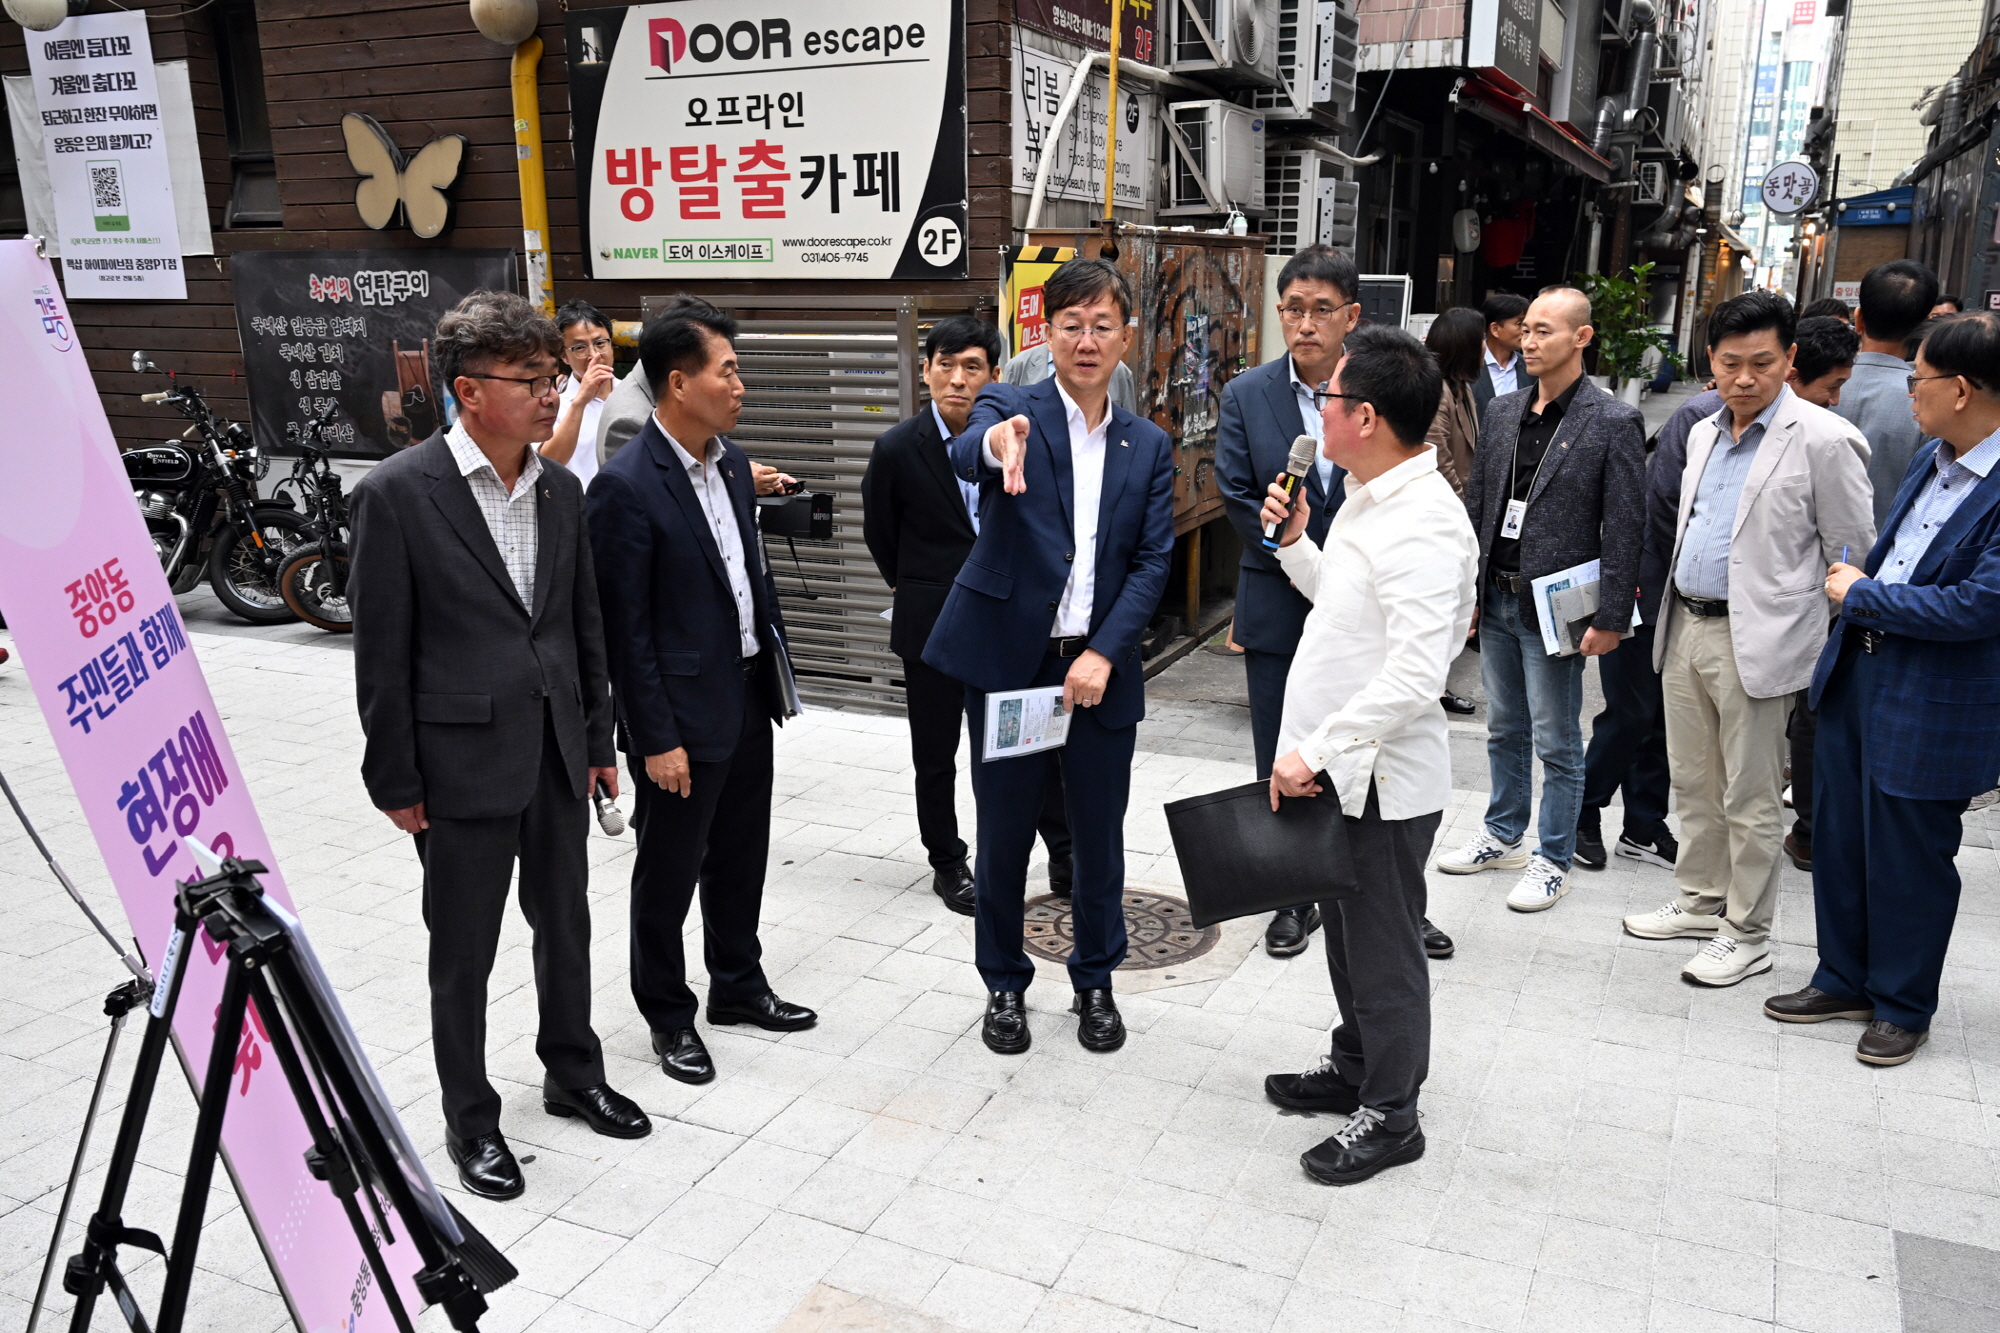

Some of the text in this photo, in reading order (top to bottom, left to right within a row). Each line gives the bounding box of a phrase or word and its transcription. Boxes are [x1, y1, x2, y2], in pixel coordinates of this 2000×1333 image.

[44, 39, 86, 61] 여름엔
[648, 18, 926, 74] DOOR escape
[1135, 26, 1153, 62] 2F
[49, 71, 138, 95] 겨울엔 춥다꼬
[1025, 65, 1060, 116] 리봄
[41, 107, 84, 126] 퇴근하고
[83, 106, 108, 123] 한잔
[685, 91, 805, 130] 오프라인
[1127, 102, 1138, 123] 2F
[54, 136, 86, 154] 운동은
[605, 139, 901, 222] 방탈출카페
[1765, 172, 1813, 200] 동맛골
[613, 244, 765, 261] NAVER 도어 이스케이프
[782, 228, 958, 256] www.doorescape.co.kr 2F
[135, 258, 178, 270] 중앙PT점
[801, 252, 869, 264] 031)405-9745
[310, 270, 429, 306] 추억의 연탄구이
[1020, 293, 1040, 319] 도어
[251, 316, 287, 336] 국내산
[290, 316, 327, 336] 일등급
[279, 343, 344, 363] 국내산 김치
[289, 369, 341, 390] 생 삼겹살
[299, 396, 311, 416] 생
[152, 457, 180, 465] ENFIELD
[64, 557, 135, 638] 중앙동
[57, 602, 187, 734] 주민들과 함께
[116, 710, 229, 877] 현장에
[350, 1258, 372, 1317] 중앙동
